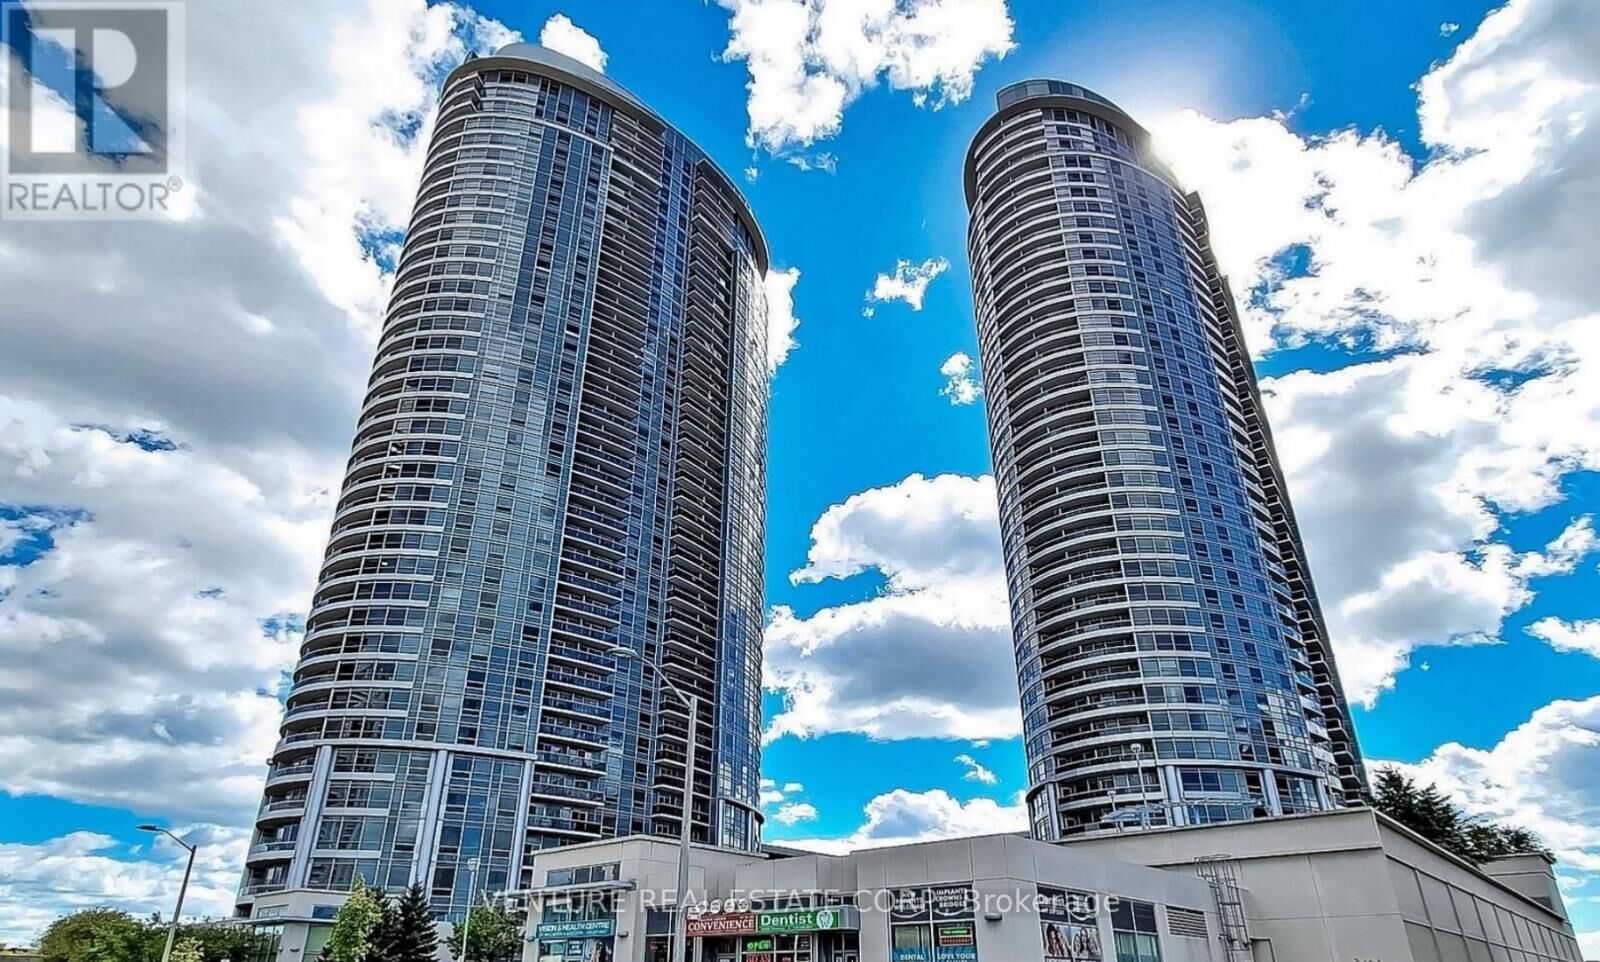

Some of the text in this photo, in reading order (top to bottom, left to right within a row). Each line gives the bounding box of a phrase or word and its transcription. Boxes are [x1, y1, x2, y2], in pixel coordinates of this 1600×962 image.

[761, 912, 813, 926] Dentist
[562, 923, 585, 931] HEALTH
[687, 919, 755, 932] CONVENIENCE
[747, 940, 771, 951] OPEN
